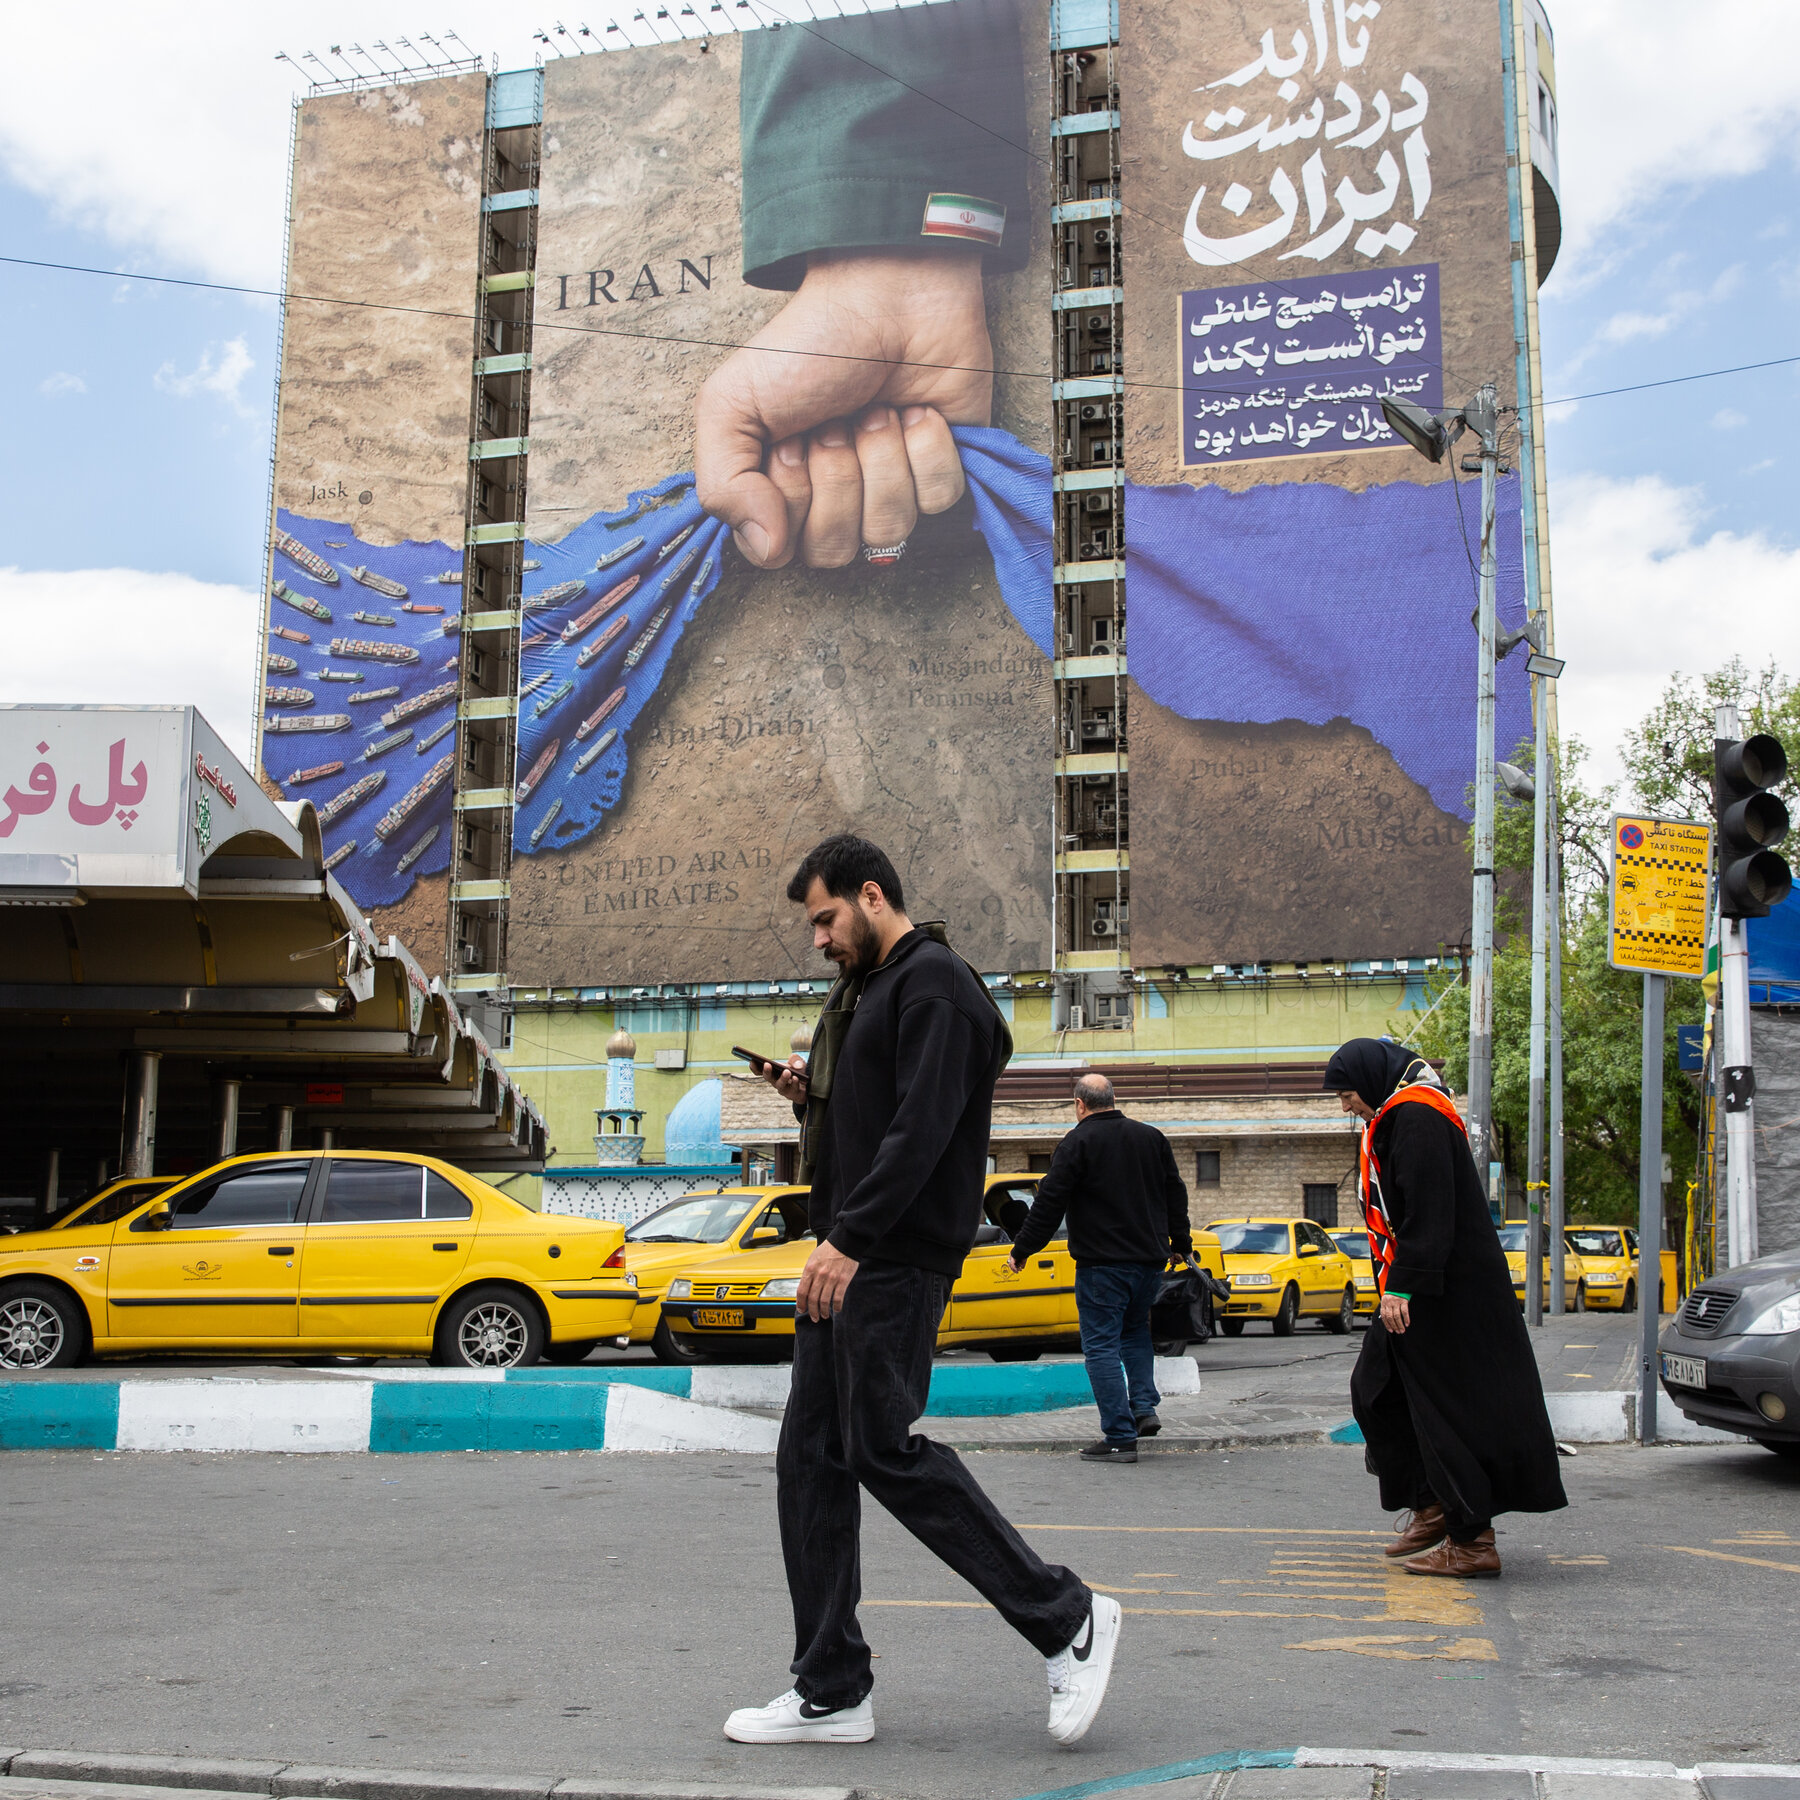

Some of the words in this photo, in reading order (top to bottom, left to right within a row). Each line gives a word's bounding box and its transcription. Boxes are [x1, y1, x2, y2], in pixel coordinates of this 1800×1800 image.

[1191, 0, 1329, 102] ابد
[1332, 0, 1382, 68] تا
[1182, 80, 1362, 161] دست
[1334, 71, 1429, 150] در
[1182, 125, 1433, 266] ایران
[554, 255, 717, 311] IRAN
[1340, 272, 1427, 322] ترامپ
[1190, 291, 1272, 336] غلطی
[1275, 289, 1338, 330] هیچ
[1192, 336, 1270, 377] بکند
[1274, 316, 1427, 366] نتوانست
[1243, 387, 1287, 409] تنگه
[1288, 382, 1373, 410] همیشگی
[1375, 372, 1430, 399] کنترل
[1193, 396, 1242, 420] هرمز
[1342, 404, 1393, 441] یران
[1193, 426, 1236, 457] بود
[1240, 410, 1338, 448] خواهد
[307, 480, 349, 505] Jask
[717, 710, 814, 745] Dhabi
[67, 737, 148, 831] پل
[1315, 819, 1462, 851] Muscat
[1650, 842, 1668, 851] TAXI
[1669, 844, 1704, 855] STATION
[1677, 828, 1709, 844] ایستگاه
[558, 854, 677, 886] UNITED
[686, 847, 773, 873] ARAB
[583, 880, 740, 915] EMIRATES
[1654, 889, 1679, 899] کرج
